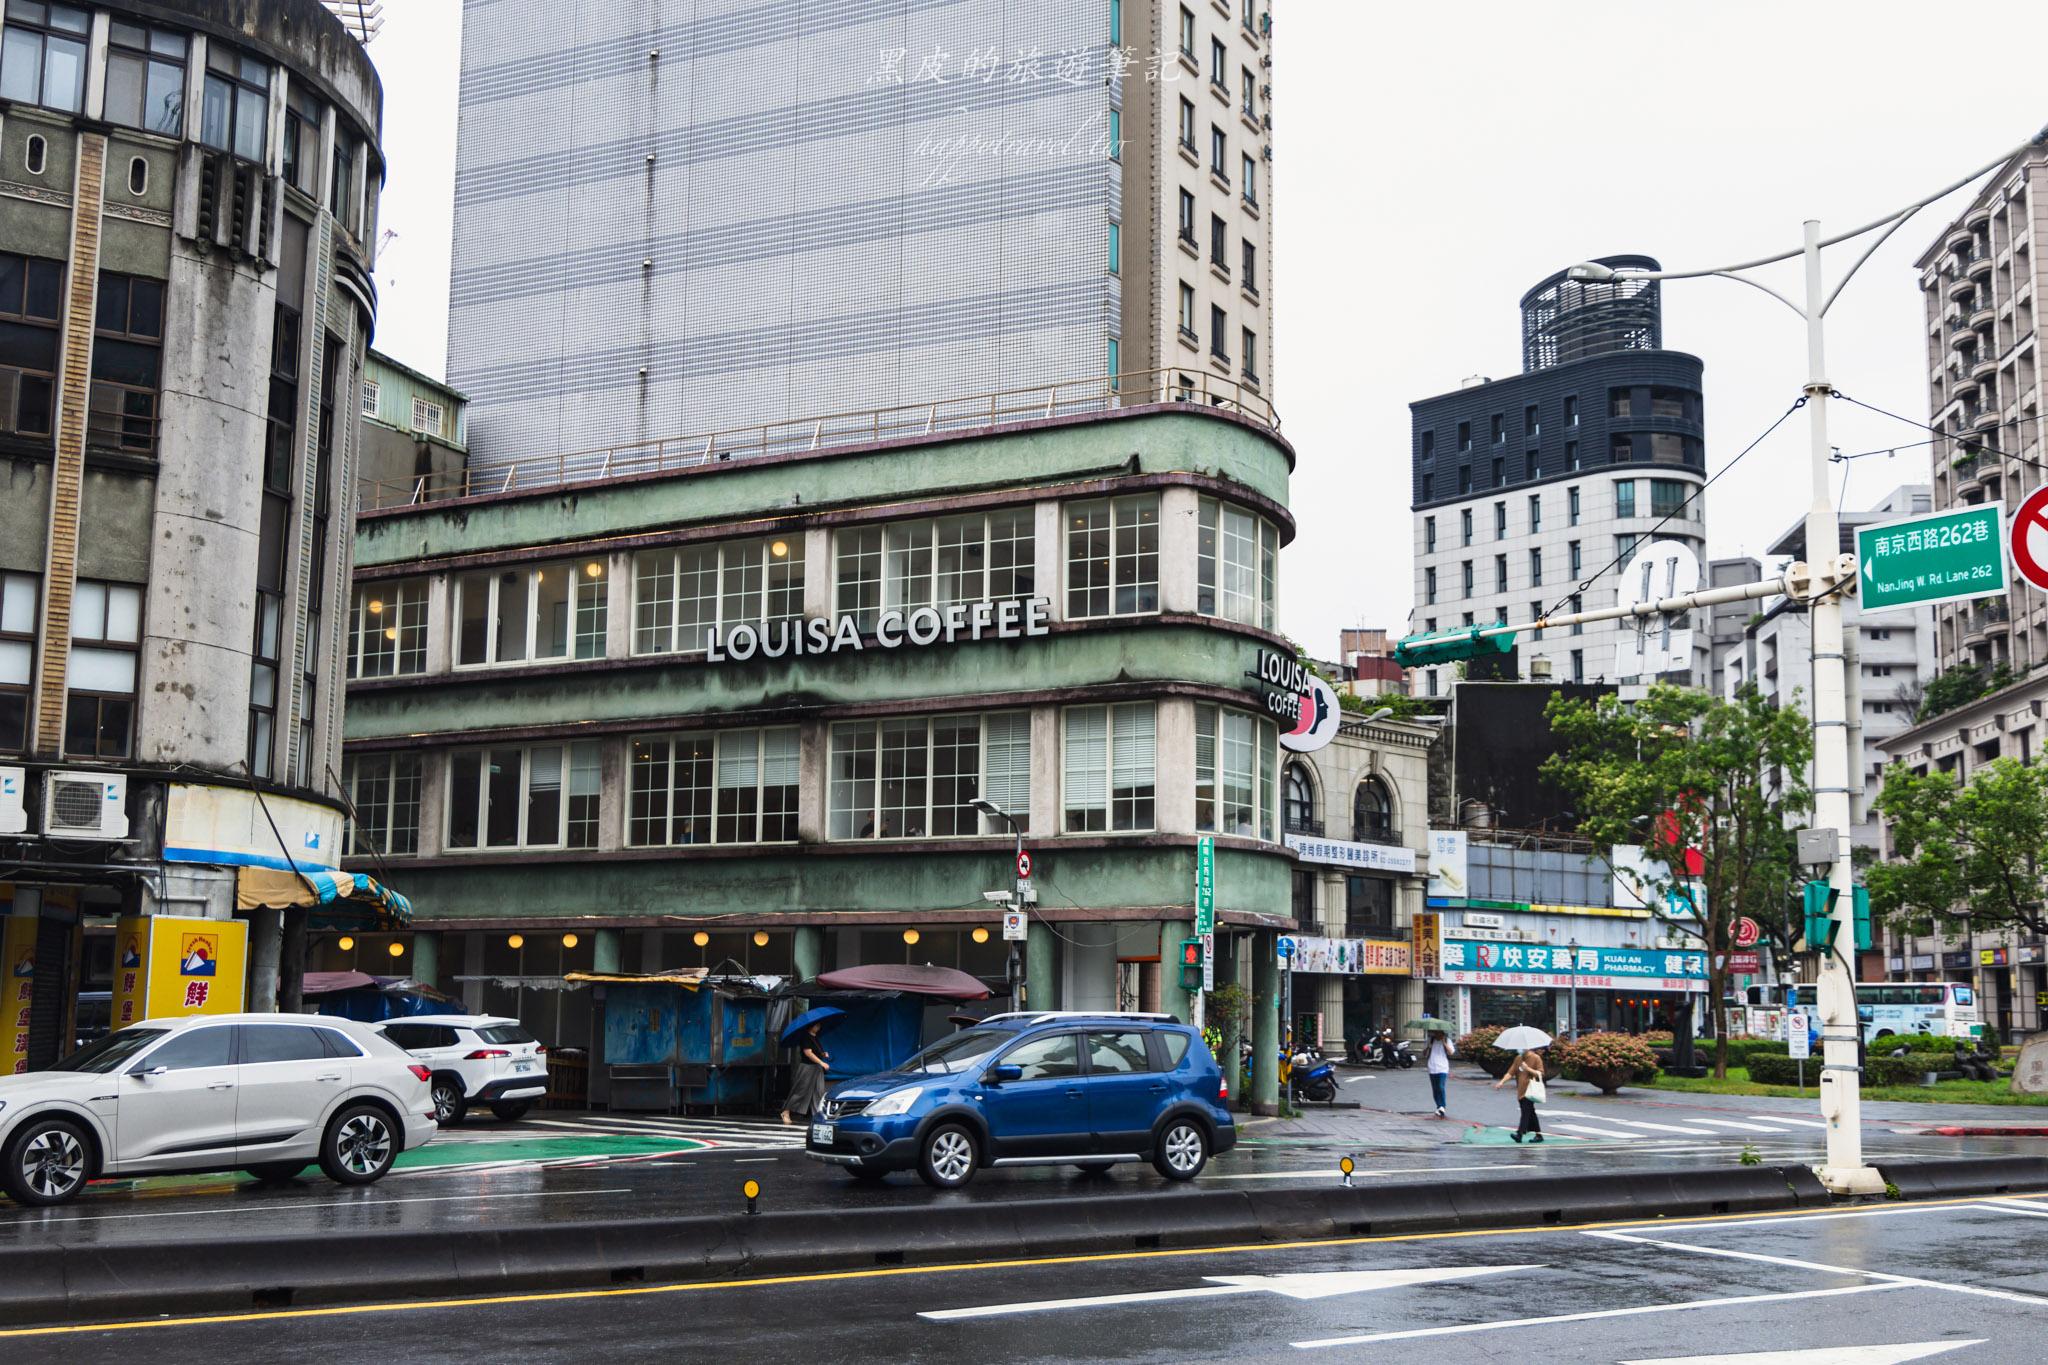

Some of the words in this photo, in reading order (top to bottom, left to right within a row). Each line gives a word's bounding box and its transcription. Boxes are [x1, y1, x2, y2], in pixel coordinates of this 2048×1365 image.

[1874, 519, 1989, 558] 南京西路262巷
[1877, 578, 1915, 594] NanJing
[1929, 573, 1943, 585] Rd.
[1946, 569, 1969, 583] Lane
[1971, 564, 1993, 579] 262
[706, 614, 863, 663] LOUISA
[876, 597, 1051, 649] COFFEE
[1261, 649, 1311, 697] LOUISA
[1268, 691, 1303, 721] COFFEE
[1502, 945, 1599, 972] 快安藥局
[1603, 964, 1656, 974] PHARMACY
[1604, 955, 1626, 964] KUAI
[1628, 956, 1642, 964] AN
[183, 980, 208, 1008] 鮮
